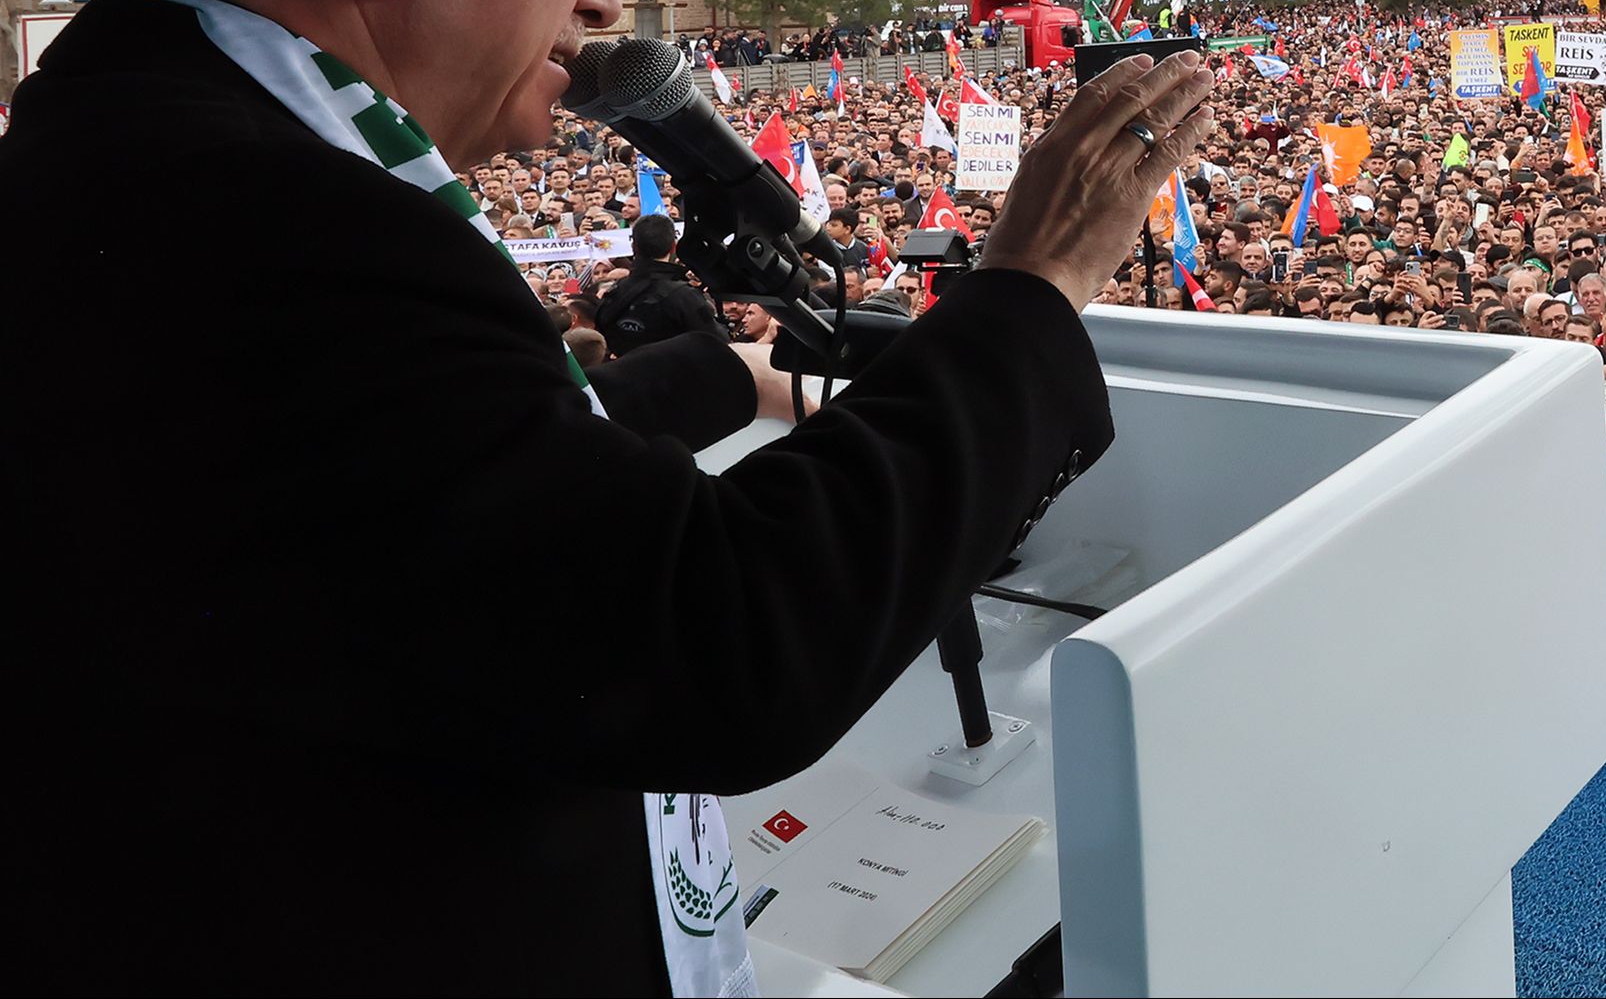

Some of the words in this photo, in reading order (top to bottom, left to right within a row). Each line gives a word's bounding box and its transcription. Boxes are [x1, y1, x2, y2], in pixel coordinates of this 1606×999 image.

[1560, 46, 1594, 60] REİS
[968, 105, 994, 118] SEN
[964, 131, 992, 145] SEN
[857, 857, 882, 871] KONYA
[838, 883, 858, 896] MART
